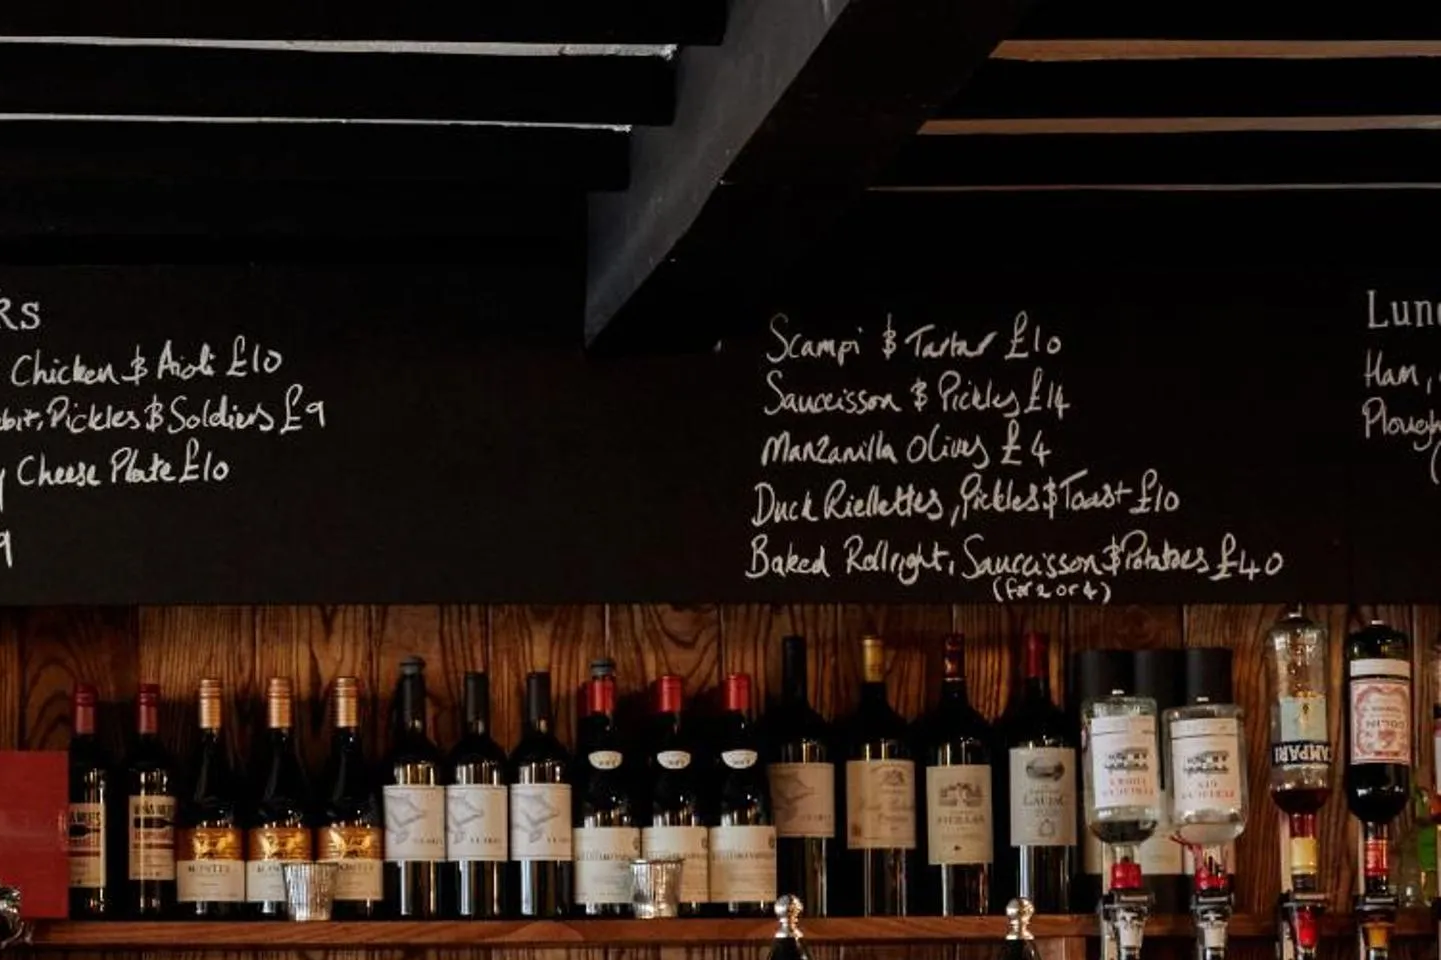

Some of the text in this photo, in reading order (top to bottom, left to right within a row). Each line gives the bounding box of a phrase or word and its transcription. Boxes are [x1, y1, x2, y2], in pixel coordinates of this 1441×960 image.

[11, 350, 122, 386] Chicken
[157, 340, 215, 379] Aioli
[226, 336, 282, 377] £10
[767, 313, 862, 365] Scampi
[905, 325, 996, 357] Tartar
[1005, 312, 1061, 359] £10
[939, 371, 1020, 417] Pickles
[1024, 368, 1069, 418] £14
[1365, 353, 1431, 393] Ham,
[46, 396, 140, 433] Pickles
[168, 395, 274, 434] Soldiers
[280, 384, 325, 434] £9
[17, 455, 101, 487] Cheese
[111, 447, 176, 483] Plate
[179, 438, 229, 483] £10
[761, 431, 897, 466] Manzanilla
[907, 424, 989, 469] Olives
[752, 482, 818, 526] Duck
[1060, 470, 1131, 512] Toast
[1128, 469, 1179, 513] £10
[745, 534, 830, 578] Baked
[1119, 530, 1209, 573] Potatoes
[1208, 533, 1283, 580] £40
[1273, 743, 1330, 764] AMPARI
